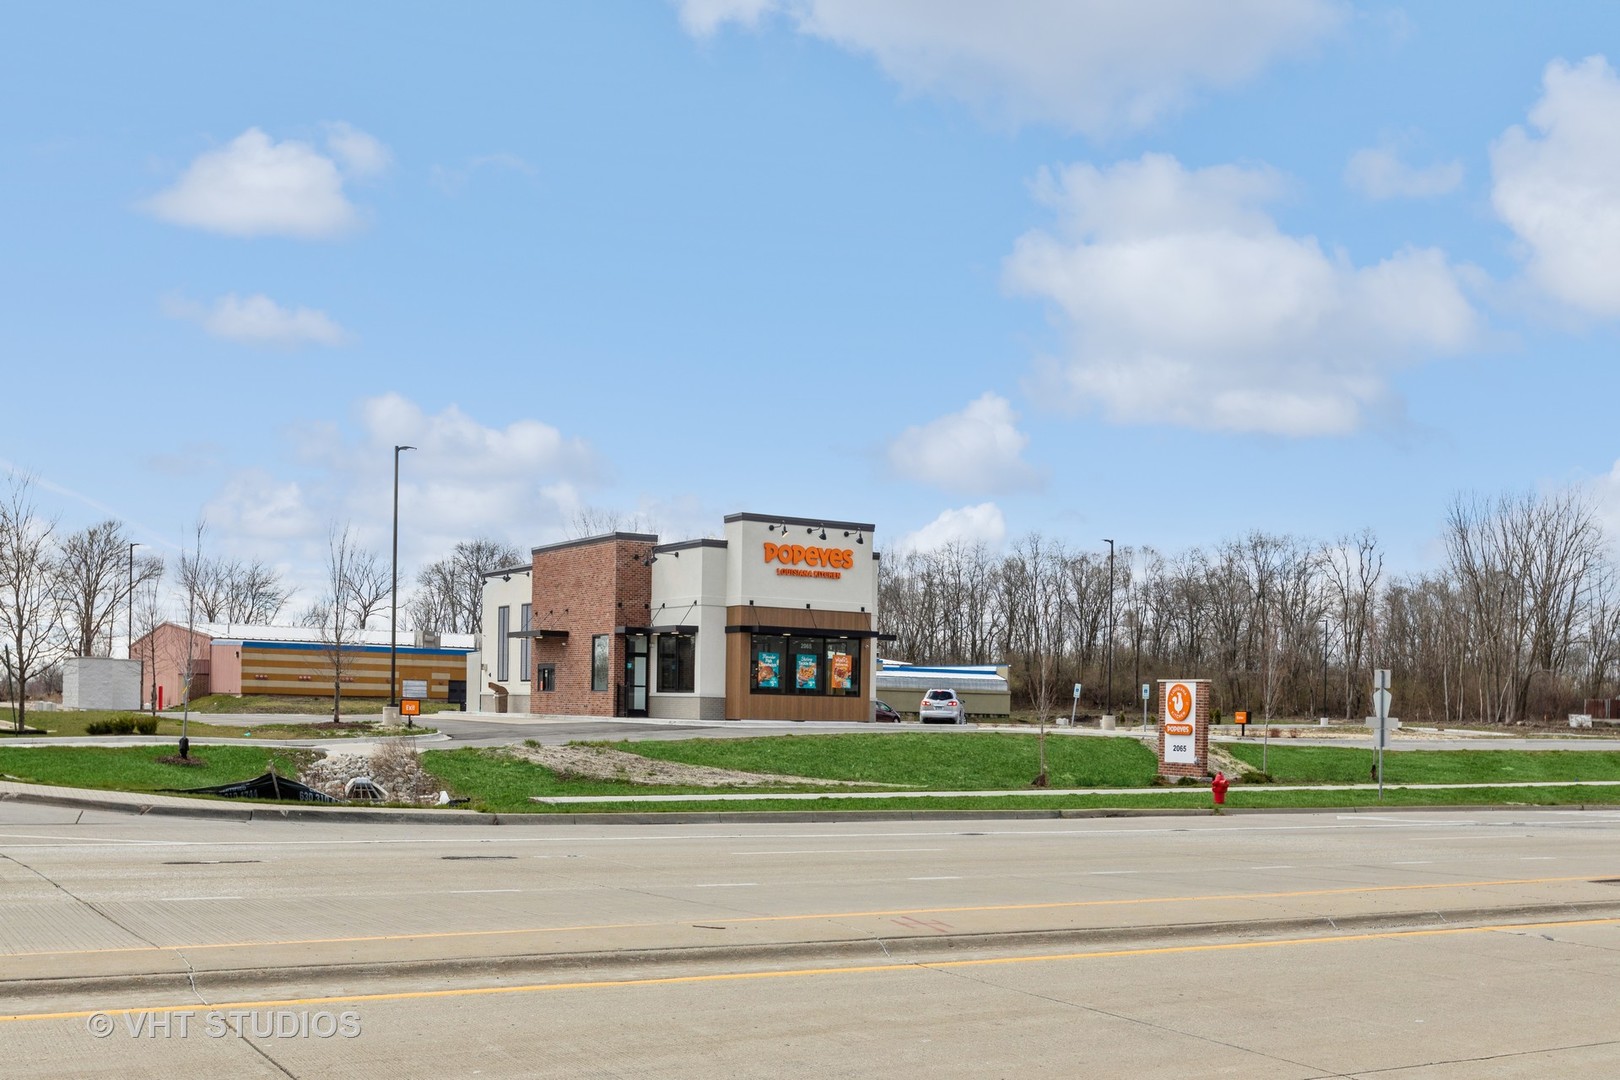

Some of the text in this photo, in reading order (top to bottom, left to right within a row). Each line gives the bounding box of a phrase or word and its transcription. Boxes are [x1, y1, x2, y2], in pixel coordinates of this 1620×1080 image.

[776, 568, 841, 580] LOUISIANA KITCHEN
[1171, 711, 1186, 719] KITCHEN
[299, 791, 313, 801] 630
